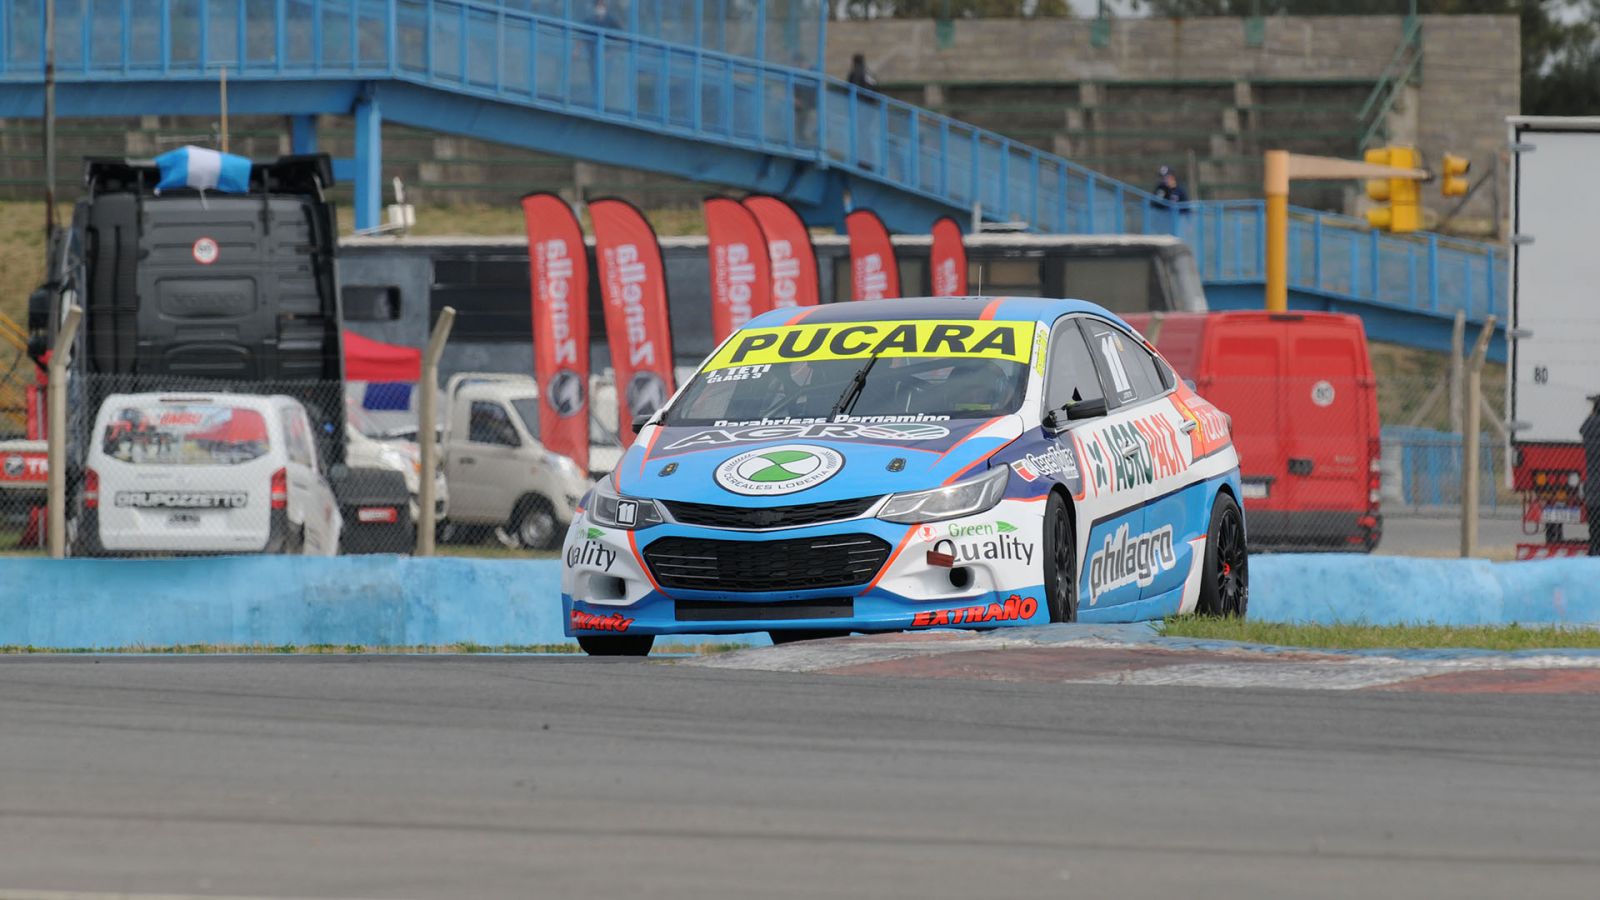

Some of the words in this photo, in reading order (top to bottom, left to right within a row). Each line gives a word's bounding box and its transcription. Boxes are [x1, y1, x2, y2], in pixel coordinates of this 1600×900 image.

[729, 324, 1016, 363] PUCARA
[728, 364, 772, 376] TETI
[1102, 335, 1130, 393] 11
[1534, 365, 1549, 385] 80
[707, 373, 751, 384] CLASE
[723, 472, 773, 491] CEREALES
[948, 522, 993, 538] Green
[933, 534, 1034, 566] Quality
[1090, 524, 1176, 605] philagro
[911, 594, 1038, 627] EXTRAÑO
